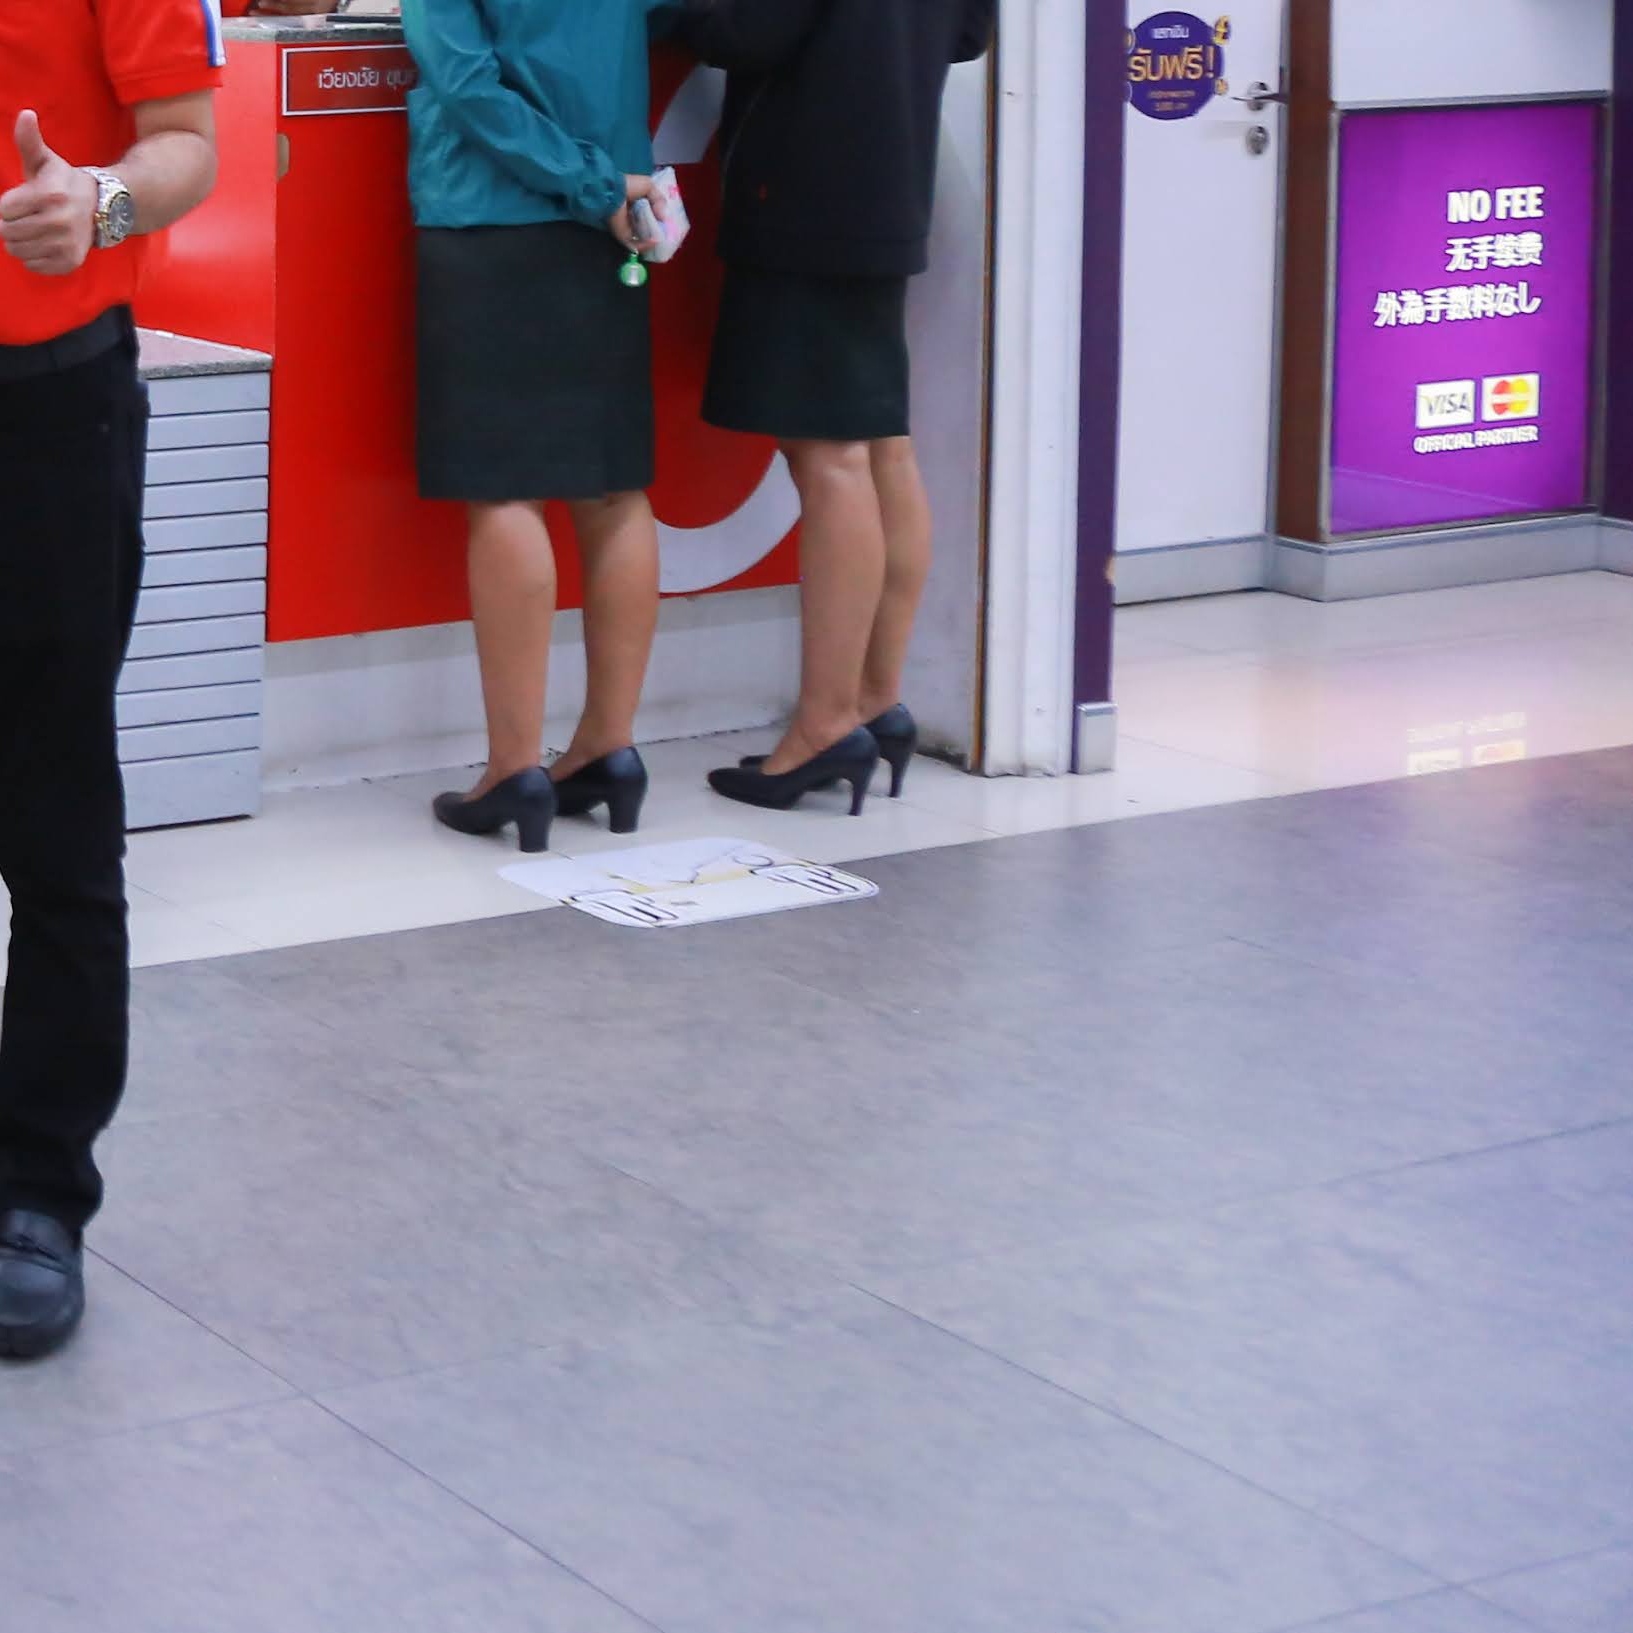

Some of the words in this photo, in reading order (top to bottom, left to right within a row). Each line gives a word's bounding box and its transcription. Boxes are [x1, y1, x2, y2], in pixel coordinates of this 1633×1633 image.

[317, 67, 380, 89] เวียงชัย
[1446, 190, 1493, 224] NO
[1495, 186, 1546, 220] FEE
[1373, 280, 1542, 328] 外為手数料なし
[1421, 389, 1473, 418] VISA
[1413, 430, 1476, 454] OFFICIAL
[1476, 424, 1540, 448] PARTNER
